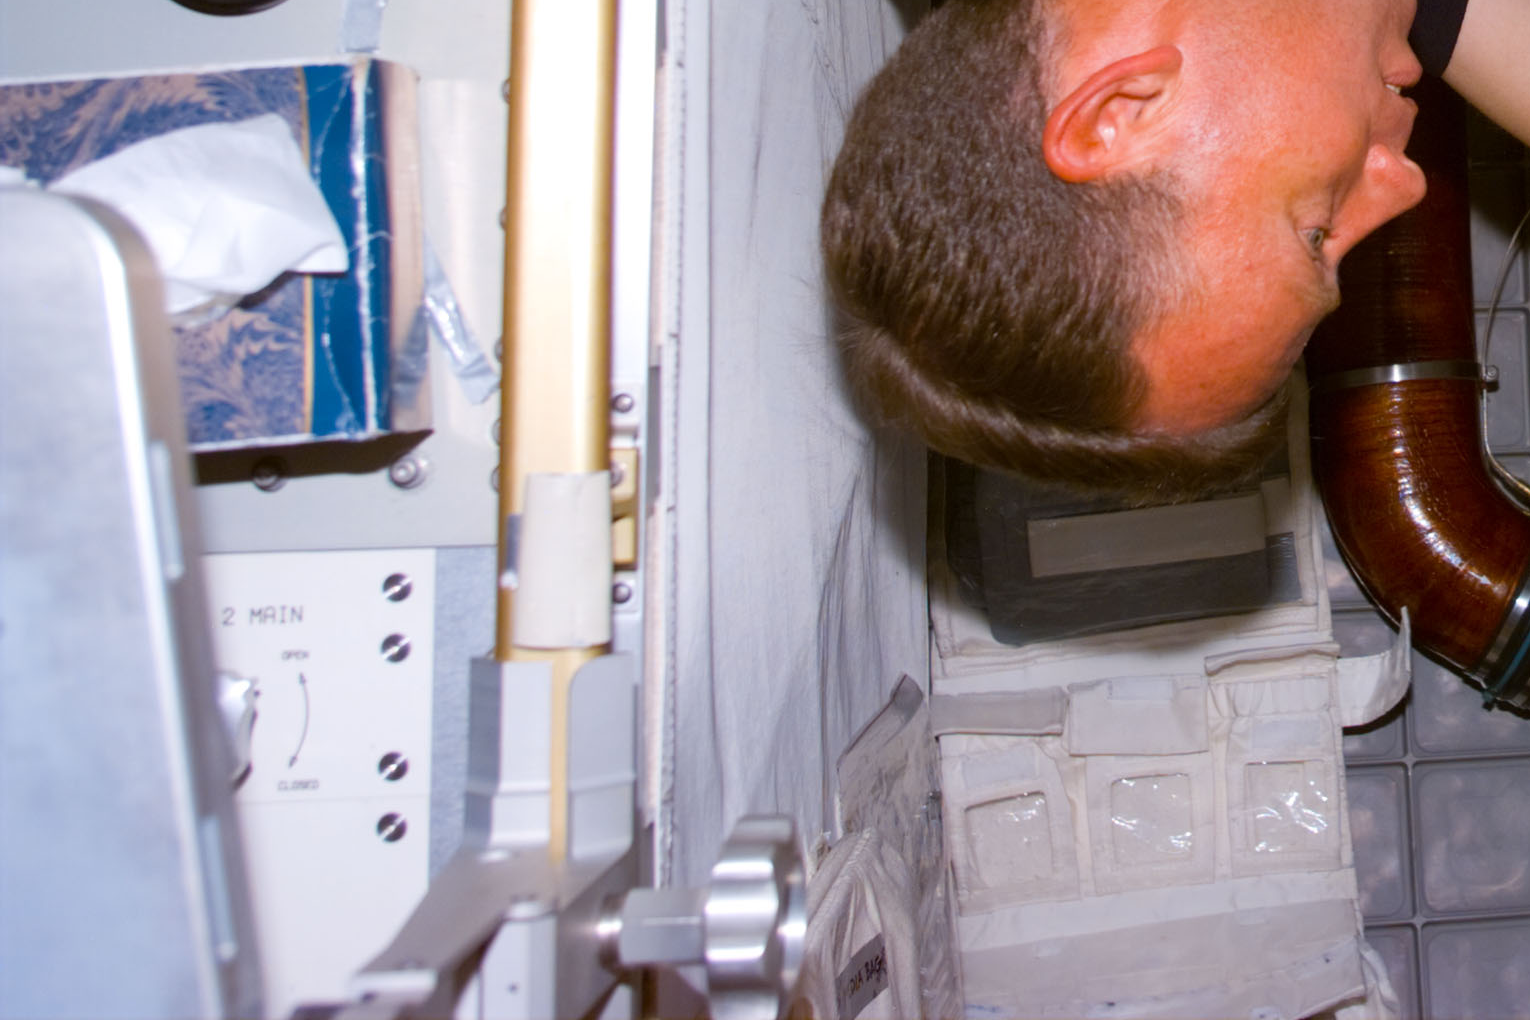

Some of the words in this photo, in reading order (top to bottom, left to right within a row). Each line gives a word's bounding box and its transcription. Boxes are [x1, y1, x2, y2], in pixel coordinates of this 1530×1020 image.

[222, 607, 235, 626] 2
[249, 605, 304, 625] MAIN
[281, 650, 310, 661] OPEN
[277, 780, 319, 792] CLOSED
